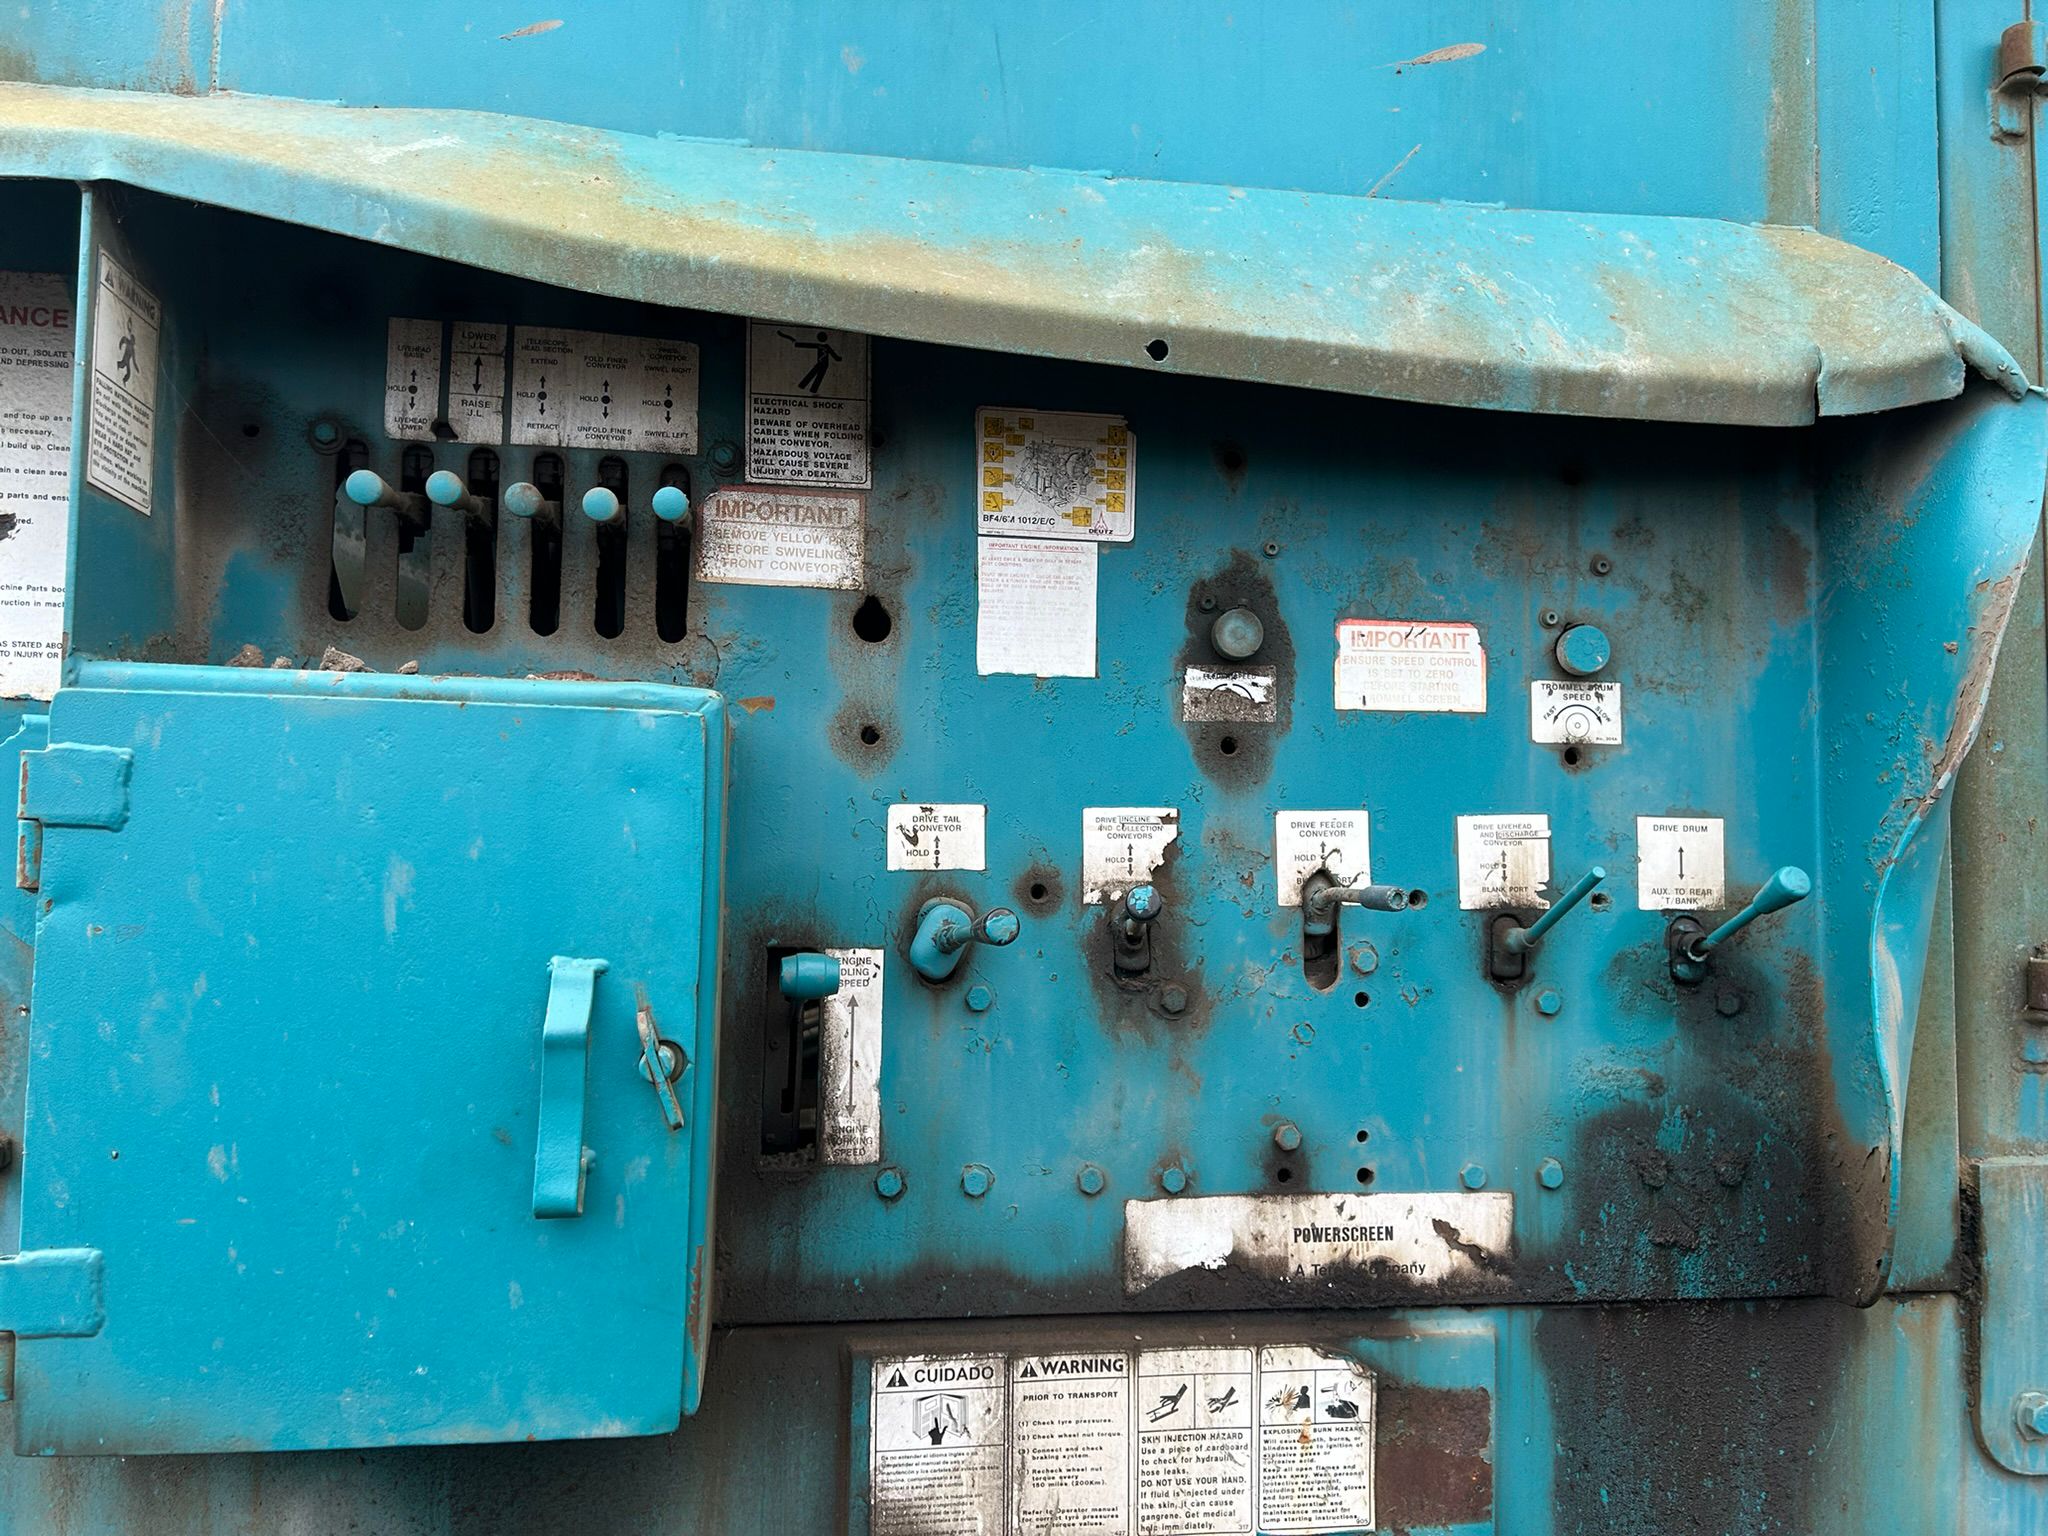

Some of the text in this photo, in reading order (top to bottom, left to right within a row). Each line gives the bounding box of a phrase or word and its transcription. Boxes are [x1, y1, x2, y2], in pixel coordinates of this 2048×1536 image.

[462, 331, 497, 341] LOWER
[11, 349, 67, 358] OUT, ISOLATE
[16, 359, 69, 368] DEPRESSING
[586, 362, 626, 370] CONVEYOR
[516, 391, 535, 399] HOLD
[580, 395, 599, 403] HOLD
[461, 400, 490, 409] RAISE
[754, 398, 844, 410] ELECTRICAL SHOCK
[754, 407, 791, 416] HAZARD
[22, 413, 36, 421] top
[754, 419, 860, 431] BEWARE OF OVERHEAD
[9, 428, 54, 437] necessary.
[577, 426, 607, 434] UNFOLD
[754, 428, 863, 440] CABLES WHEN FOLDING
[585, 433, 625, 442] CONVEYOR
[7, 442, 71, 452] build Clean
[754, 437, 832, 448] MAIN CONVEYOR.
[753, 448, 852, 460] HAZARDOUS VOLTAGE
[754, 458, 849, 469] WILL CAUSE SEVERE
[24, 467, 46, 475] clean
[753, 467, 840, 479] INJURY OR DEATH.
[7, 492, 29, 501] parts
[715, 498, 847, 524] IMPORTANT
[1018, 517, 1055, 526] 1012/E/C
[716, 529, 822, 544] REMOVE YELLOW
[719, 544, 842, 559] BEFORE SWIVELING
[722, 557, 839, 574] FRONT CONVEYOR
[1351, 630, 1470, 650] IMPORTANT
[14, 650, 43, 658] INJURY
[1343, 655, 1478, 668] ENSURE SPEED CONTROL
[1383, 669, 1453, 679] SET TO ZERO
[1541, 684, 1585, 692] TROMMEL
[1563, 693, 1591, 701] SPEED
[912, 824, 961, 832] CONVEYOR
[1291, 821, 1354, 830] DRIVE FEEDER
[1653, 824, 1708, 833] DRIVE DRUM
[1299, 830, 1346, 838] CONVEYOR
[1497, 830, 1539, 838] DISCHARGE
[1294, 854, 1317, 862] HOLD
[1480, 862, 1499, 870] HOLD
[1651, 888, 1713, 896] AUX. TO REAR
[1665, 896, 1699, 906] T/BANK
[840, 968, 869, 976] DLING
[839, 979, 869, 987] SPEED
[831, 1125, 868, 1134] ENGINE
[833, 1148, 866, 1156] SPEED
[1293, 1226, 1394, 1243] POWERSCREEN
[1295, 1266, 1305, 1277] A
[1041, 1358, 1124, 1375] WARNING
[914, 1366, 994, 1383] CUIDADO
[1023, 1394, 1050, 1402] PRIOR
[1068, 1391, 1118, 1400] TRANSPORT
[1097, 1431, 1124, 1439] torque.
[1141, 1432, 1243, 1444] SKIN INJECTION HAZARD
[1141, 1445, 1190, 1455] Use piece
[1032, 1453, 1058, 1461] braking
[1154, 1455, 1192, 1464] check for
[1141, 1467, 1188, 1476] hose leaks.
[1141, 1479, 1152, 1487] DO
[1156, 1478, 1173, 1486] NOT
[1176, 1477, 1192, 1485] USE
[1196, 1476, 1218, 1485] YOUR
[1221, 1487, 1245, 1495] under
[1141, 1509, 1236, 1521] gangrene. Get medical
